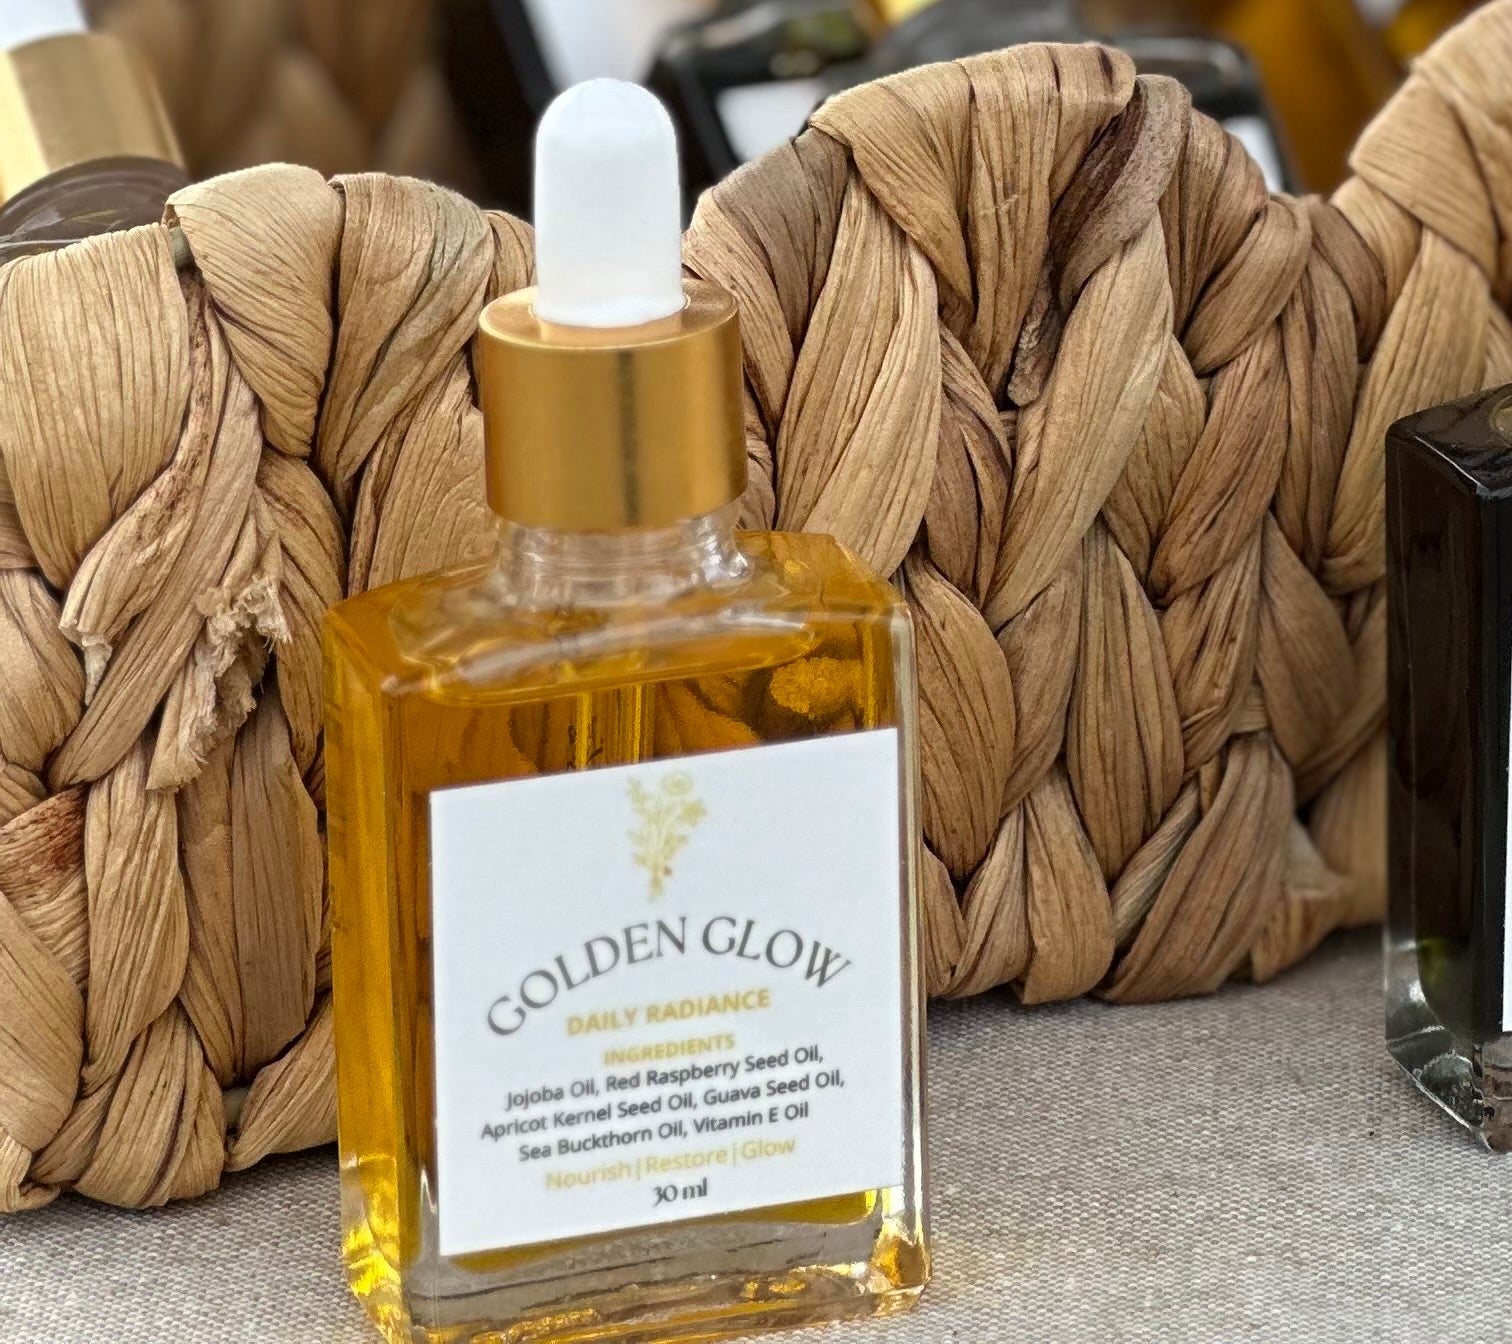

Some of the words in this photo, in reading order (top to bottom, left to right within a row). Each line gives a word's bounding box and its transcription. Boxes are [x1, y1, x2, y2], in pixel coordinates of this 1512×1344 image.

[487, 916, 687, 1035] GOLDEN
[702, 916, 851, 988] GLOW
[566, 1008, 639, 1035] DAILY
[645, 988, 770, 1023] RADIANCE
[505, 1086, 564, 1112] Jojoba
[570, 1078, 599, 1098] Oil,
[606, 1071, 641, 1092] Red
[646, 1060, 740, 1087] Raspberry
[745, 1049, 789, 1072] Seed
[794, 1045, 824, 1064] Oil,
[604, 1033, 735, 1065] INGREDIENTS
[481, 1116, 548, 1142] Apricot
[552, 1104, 612, 1128] Kernel
[617, 1096, 662, 1118] Seed
[668, 1092, 697, 1112] Oil,
[703, 1085, 761, 1105] Guava
[766, 1074, 810, 1097] Seed
[815, 1069, 845, 1089] Oil,
[519, 1144, 552, 1162] Sea
[558, 1128, 652, 1155] Buckthorn
[658, 1120, 687, 1140] Oil,
[693, 1111, 763, 1133] Vitamin
[768, 1107, 780, 1124] E
[784, 1101, 810, 1121] Oil
[653, 1185, 679, 1207] 30
[683, 1177, 708, 1199] ml
